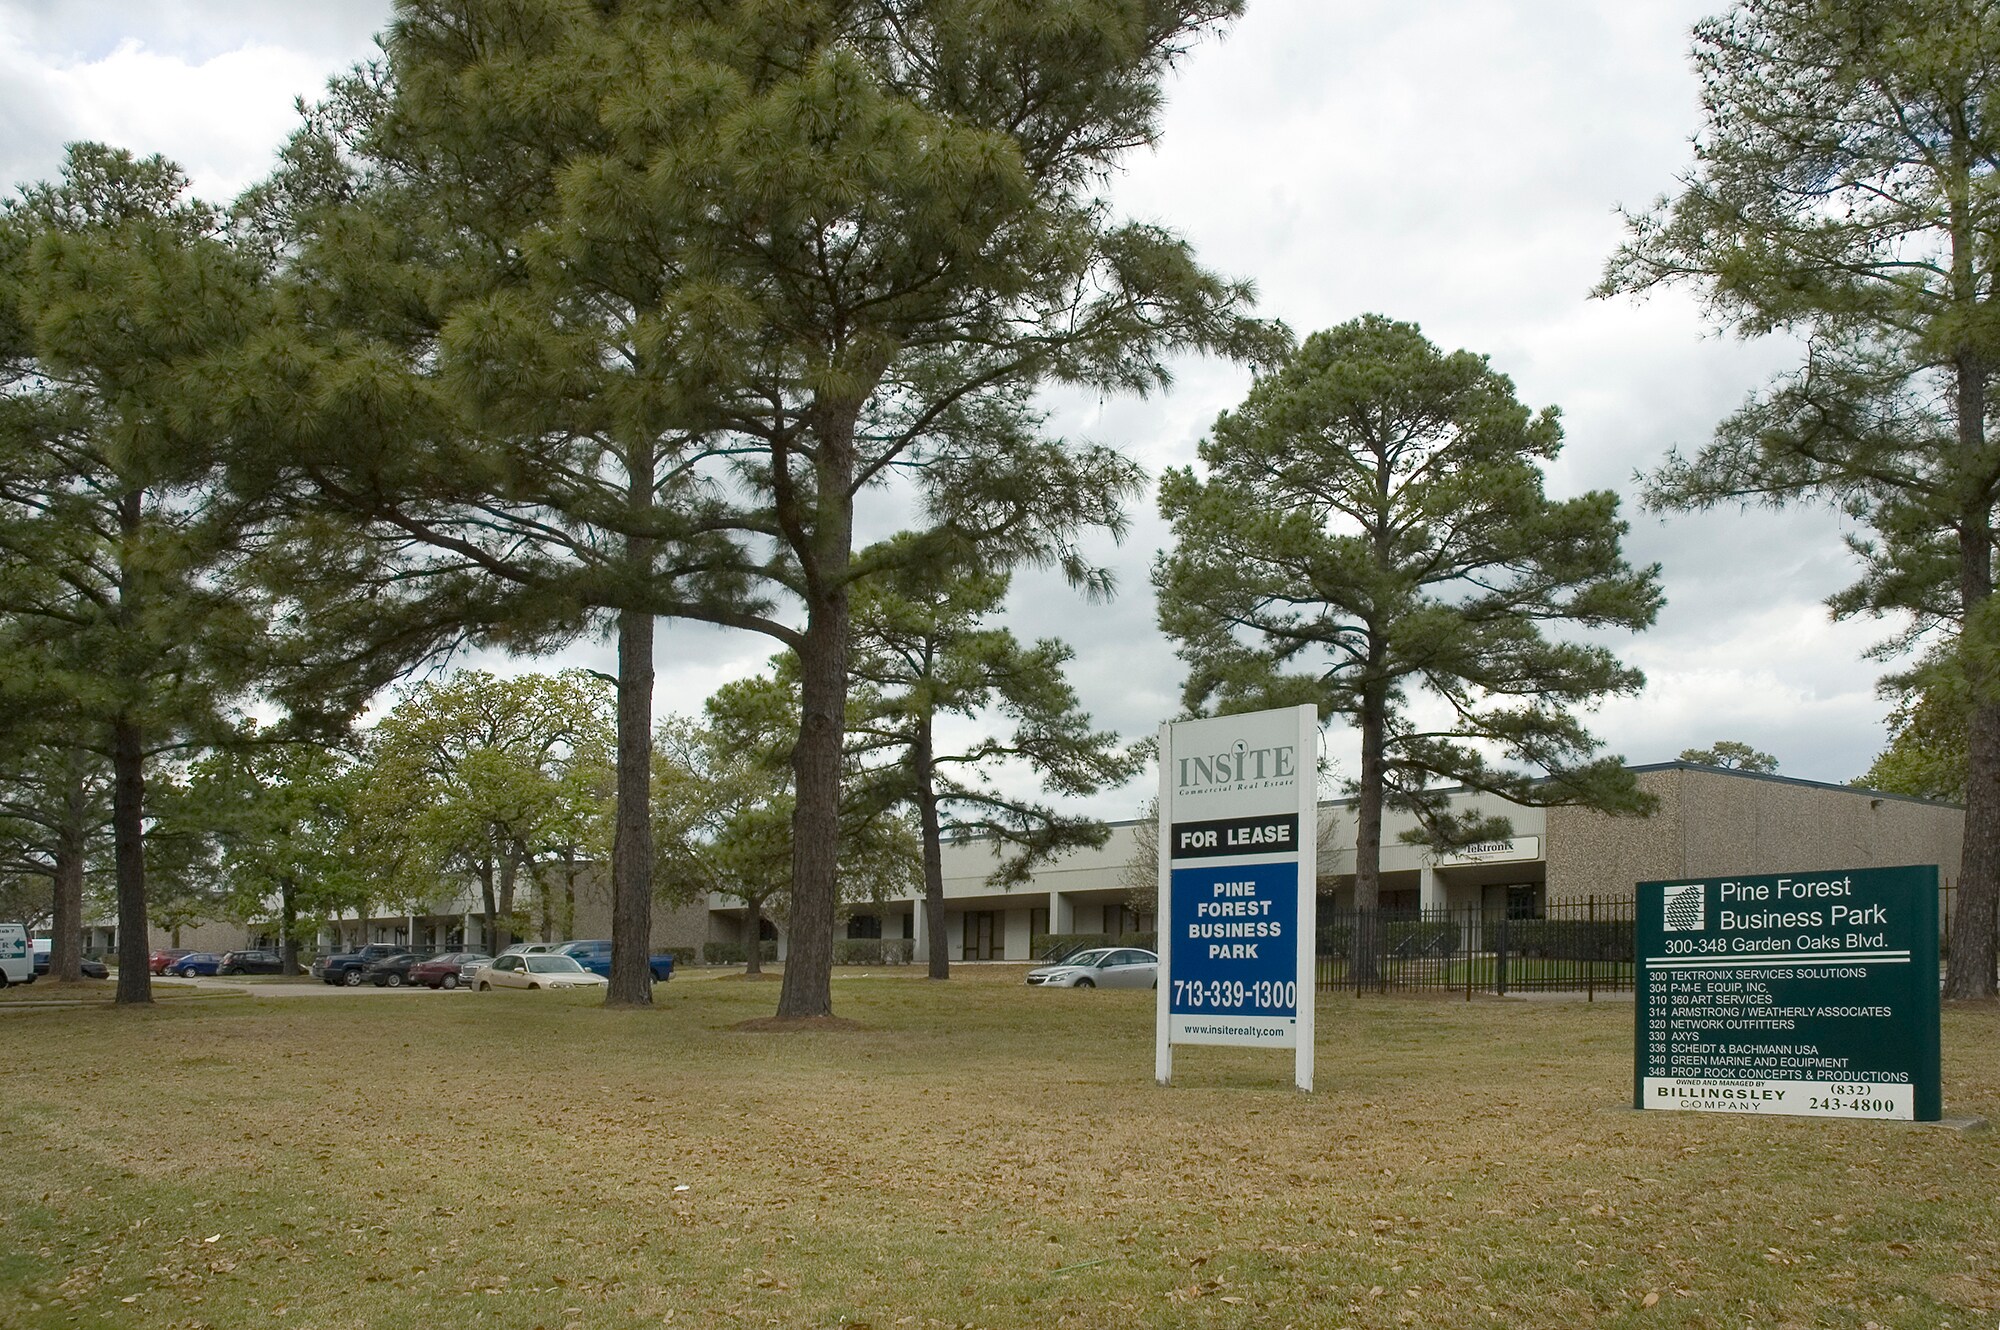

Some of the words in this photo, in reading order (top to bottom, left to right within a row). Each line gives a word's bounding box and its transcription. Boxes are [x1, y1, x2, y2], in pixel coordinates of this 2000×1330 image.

[1179, 784, 1232, 796] Commercial
[1237, 782, 1259, 791] Real
[1264, 779, 1295, 788] Estate
[1181, 830, 1218, 849] FOR
[1228, 825, 1290, 846] LEASE
[1214, 881, 1256, 897] PINE
[1720, 882, 1769, 902] Pine
[1777, 876, 1851, 899] Forest
[1198, 901, 1272, 917] FOREST
[1720, 908, 1822, 930] Business
[1831, 904, 1887, 925] Park
[1189, 922, 1281, 938] BUSINESS
[1664, 938, 1727, 954] 300-348
[1732, 936, 1791, 952] Garden
[1797, 934, 1840, 949] Oaks
[1846, 933, 1888, 949] Blvd.
[1209, 944, 1258, 959] PARK
[1649, 971, 1667, 981] 300
[1671, 970, 1733, 981] TEKTRONIX
[1736, 969, 1793, 980] SERVICES
[1796, 968, 1867, 979] SOLUTIONS
[1174, 980, 1296, 1009] 713-339-1300
[1649, 983, 1667, 993] 304
[1671, 983, 1701, 992] P-M-E
[1707, 982, 1743, 993] EQUIP,
[1746, 983, 1768, 993] INC.
[1649, 995, 1667, 1005] 310
[1671, 995, 1689, 1005] 360
[1691, 995, 1713, 1005] ART
[1716, 994, 1773, 1005] SERVICES
[1649, 1007, 1667, 1017] 314
[1671, 1007, 1739, 1017] ARMSTRONG
[1741, 1007, 1746, 1017] /
[1748, 1006, 1816, 1017] WEATHERLY
[1816, 1006, 1891, 1017] ASSOCIATES
[1649, 1019, 1666, 1029] 320
[1670, 1019, 1724, 1029] NETWORK
[1726, 1019, 1795, 1029] OUTFITTERS
[1184, 1025, 1284, 1038] www.insiterealty.com
[1649, 1031, 1666, 1041] 330
[1671, 1031, 1699, 1041] AXYS
[1649, 1043, 1666, 1053] 336
[1671, 1043, 1717, 1053] SCHEIDT
[1719, 1044, 1726, 1053] &
[1729, 1044, 1791, 1055] BACHMANN
[1795, 1045, 1819, 1055] USA
[1649, 1055, 1666, 1065] 340
[1671, 1056, 1707, 1065] GREEN
[1710, 1056, 1751, 1066] MARINE
[1754, 1057, 1777, 1067] AND
[1780, 1057, 1849, 1068] EQUIPMENT
[1649, 1067, 1666, 1076] 348
[1671, 1067, 1701, 1077] PROP
[1704, 1068, 1736, 1078] ROCK
[1739, 1068, 1802, 1080] CONCEPTS
[1806, 1070, 1814, 1080] &
[1817, 1070, 1909, 1082] PRODUCTIONS
[1676, 1078, 1701, 1086] OWNED
[1719, 1079, 1754, 1087] MANAGED
[1831, 1083, 1871, 1095] (832)
[1657, 1087, 1786, 1101] BILLINGSLEY
[1680, 1100, 1761, 1111] COMPANY
[1809, 1097, 1894, 1112] 243-4800
